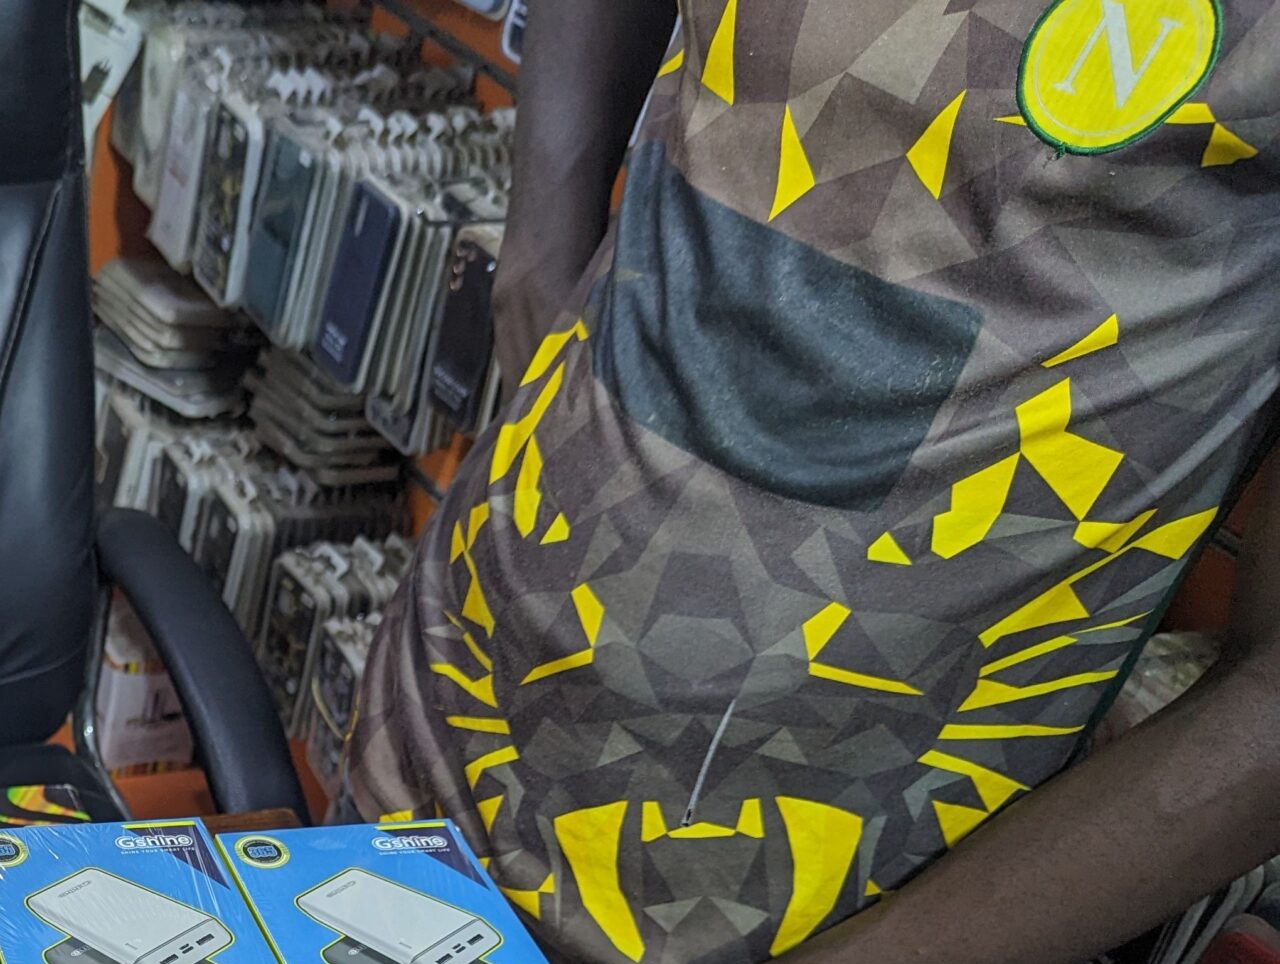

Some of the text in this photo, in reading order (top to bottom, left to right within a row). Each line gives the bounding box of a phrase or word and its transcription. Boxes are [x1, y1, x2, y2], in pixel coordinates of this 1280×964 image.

[1053, 0, 1183, 110] N
[115, 835, 193, 849] Gshine
[372, 836, 447, 850] Gshine
